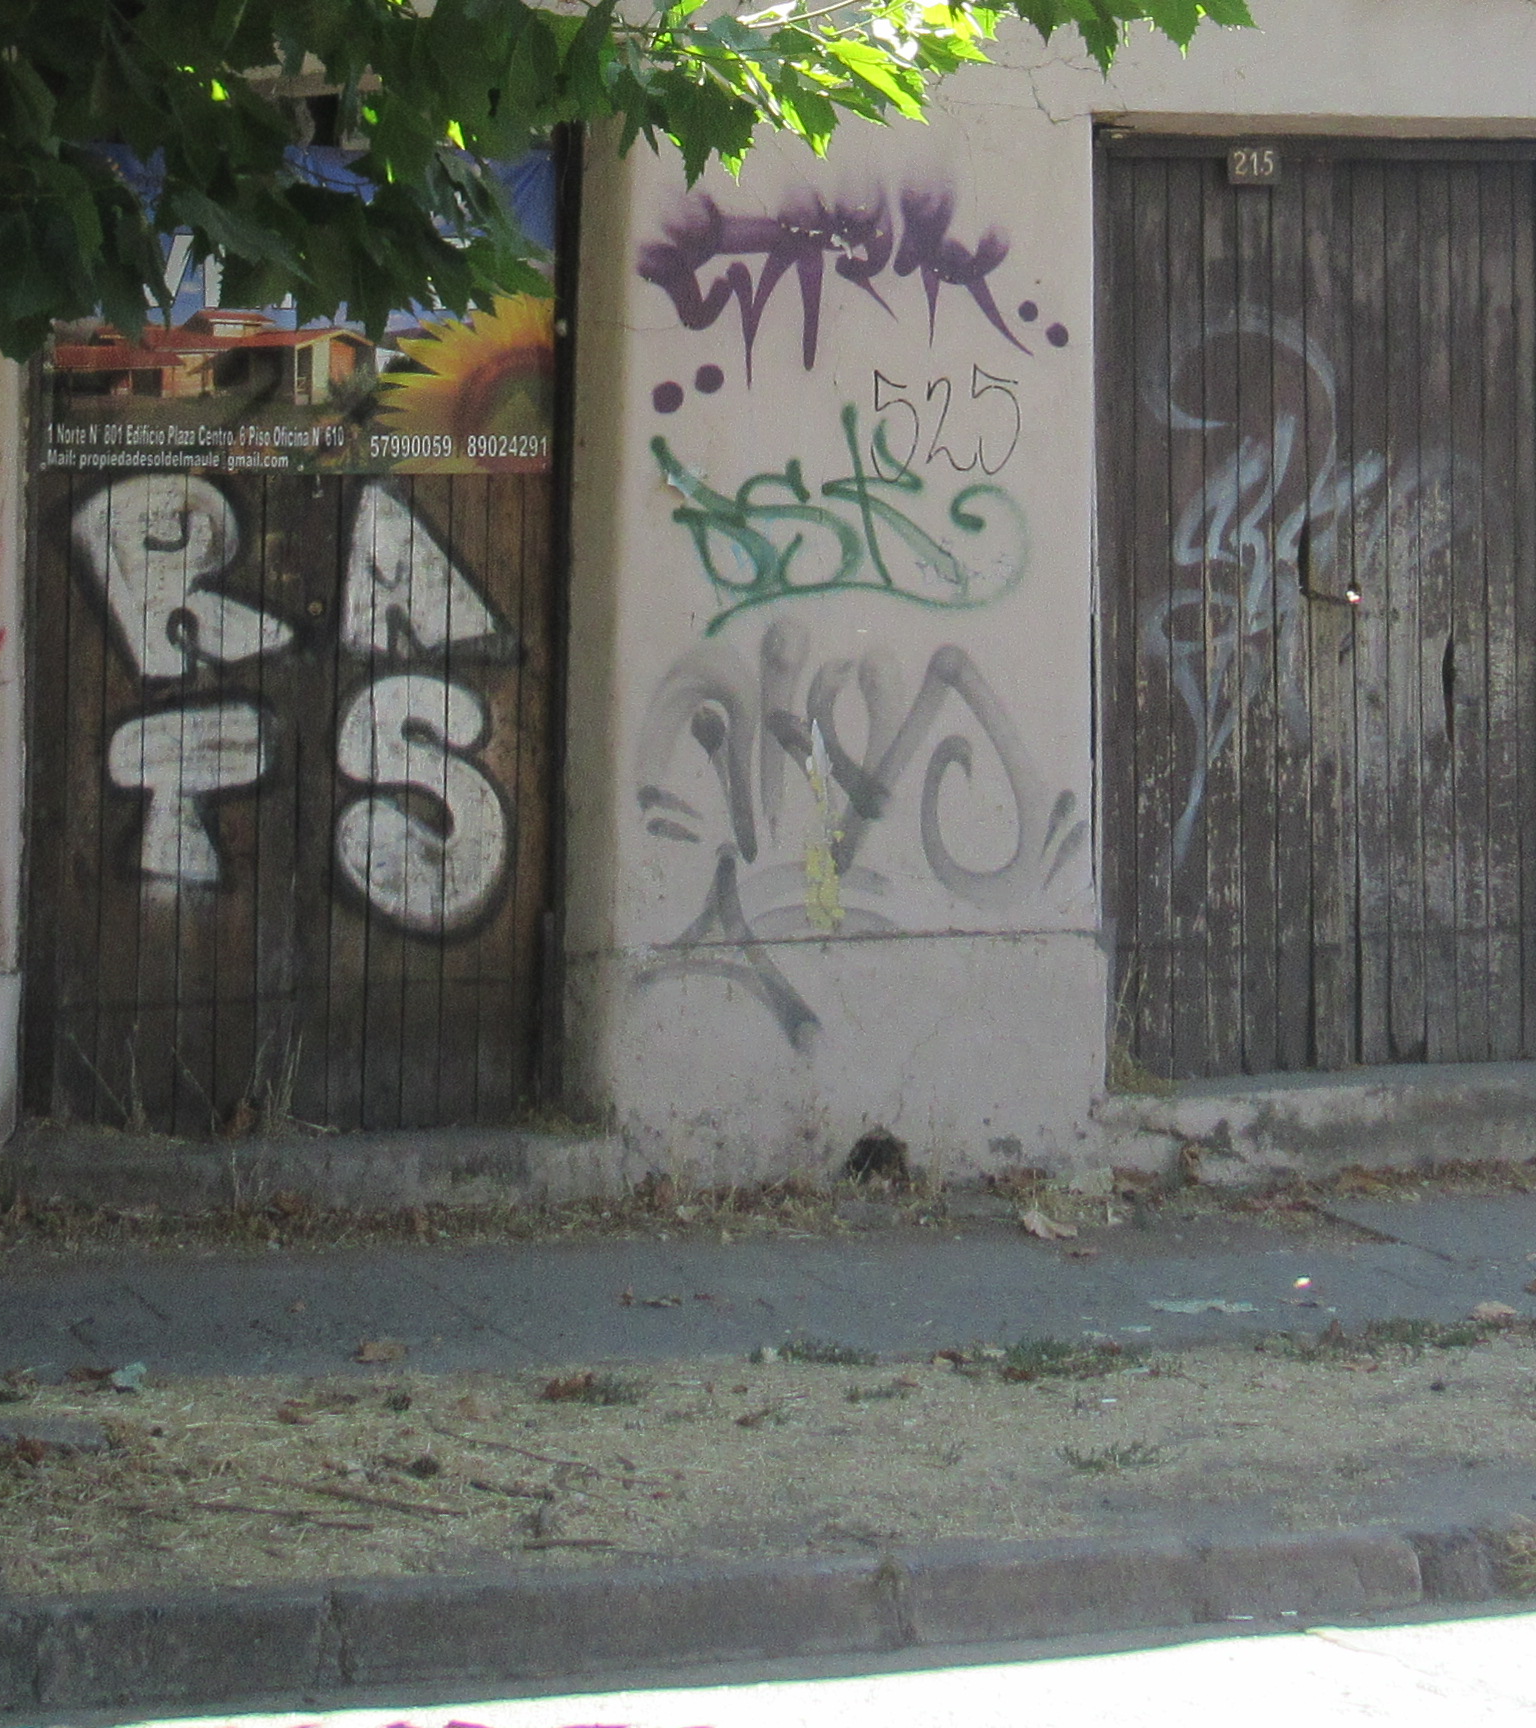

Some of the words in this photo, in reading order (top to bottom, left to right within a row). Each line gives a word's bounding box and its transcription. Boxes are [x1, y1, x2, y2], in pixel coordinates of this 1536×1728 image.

[1233, 150, 1274, 177] 215
[870, 362, 1022, 483] 525
[57, 423, 86, 445] Norte
[167, 424, 196, 446] Plaza
[248, 424, 271, 446] Piso
[273, 424, 309, 446] Oficina
[325, 425, 345, 447] 610
[369, 435, 453, 459] 57990059
[466, 435, 549, 459] 89024291
[47, 449, 77, 466] Mail:
